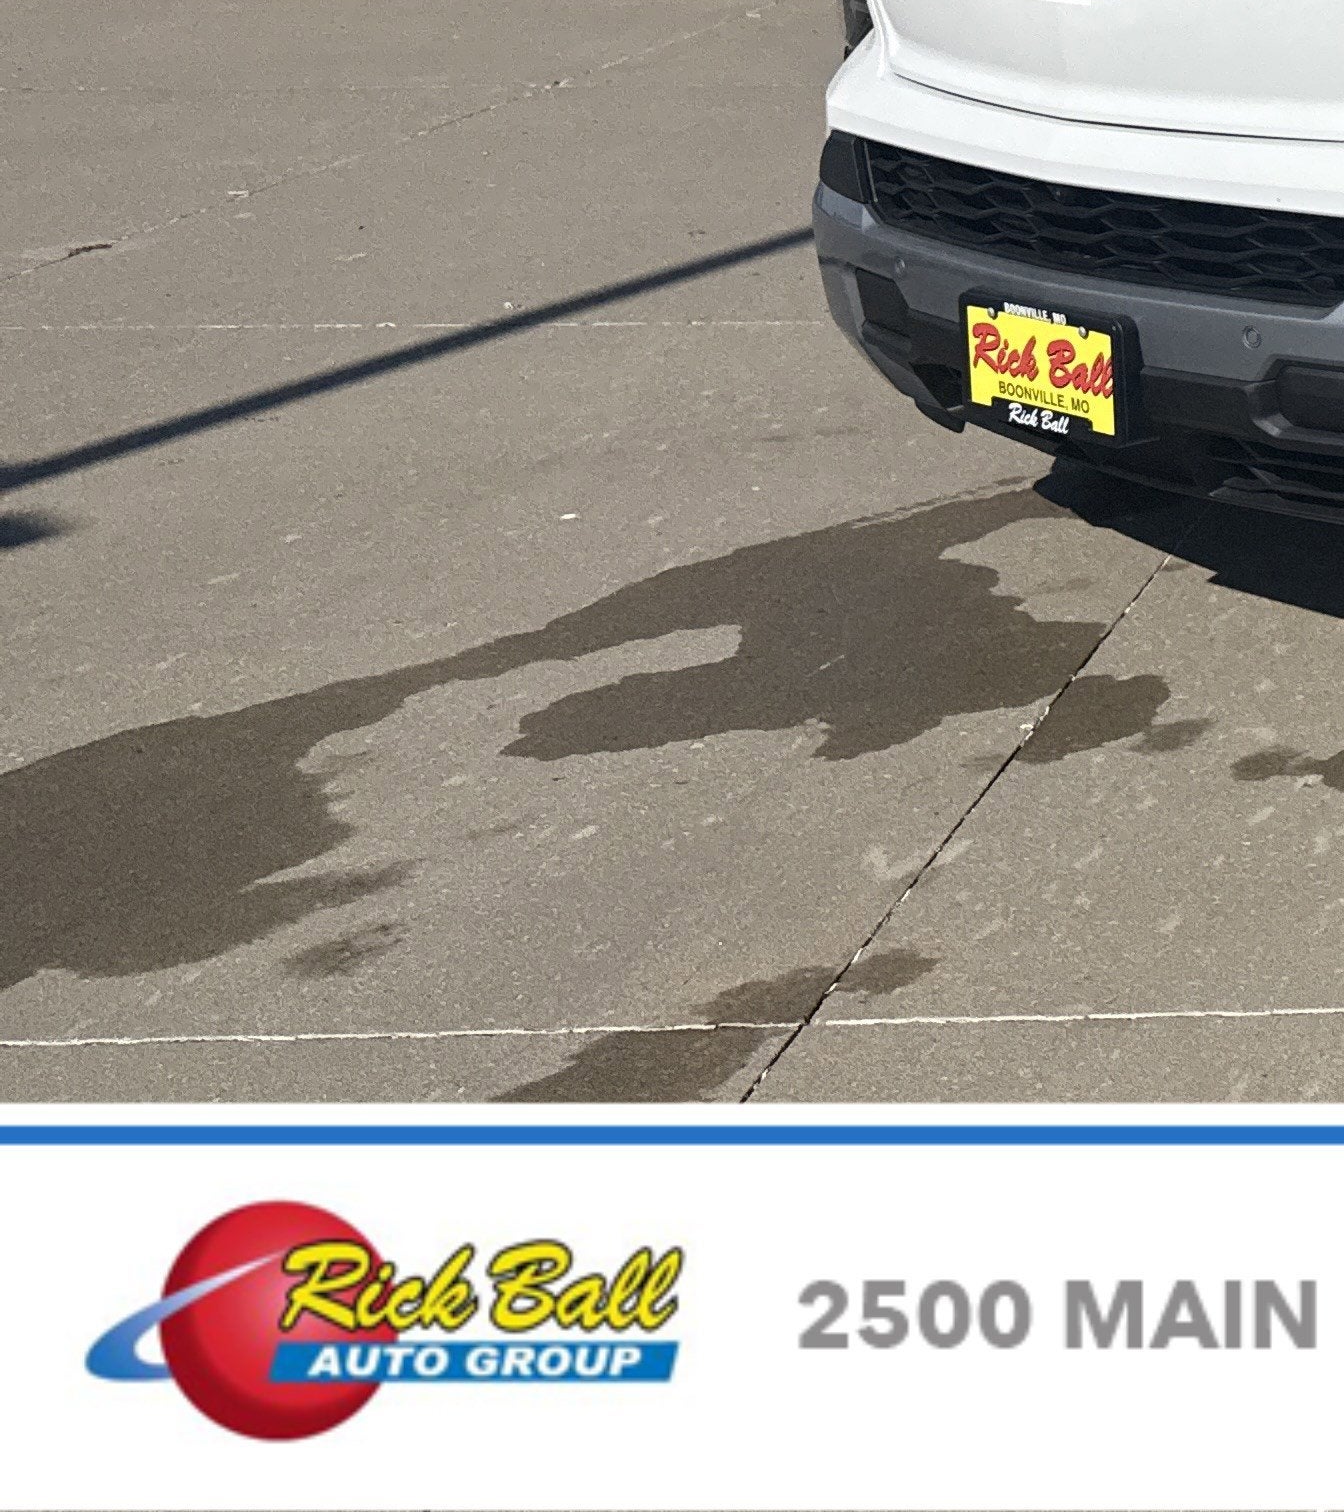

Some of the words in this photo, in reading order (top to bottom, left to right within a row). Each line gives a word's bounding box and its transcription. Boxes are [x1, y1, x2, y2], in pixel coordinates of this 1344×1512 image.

[972, 322, 1039, 382] Rick
[1046, 339, 1114, 399] Ball
[998, 380, 1069, 410] BOONVILLE,
[1071, 397, 1090, 414] MO
[1008, 403, 1040, 428] Rick
[1040, 409, 1070, 435] Ball
